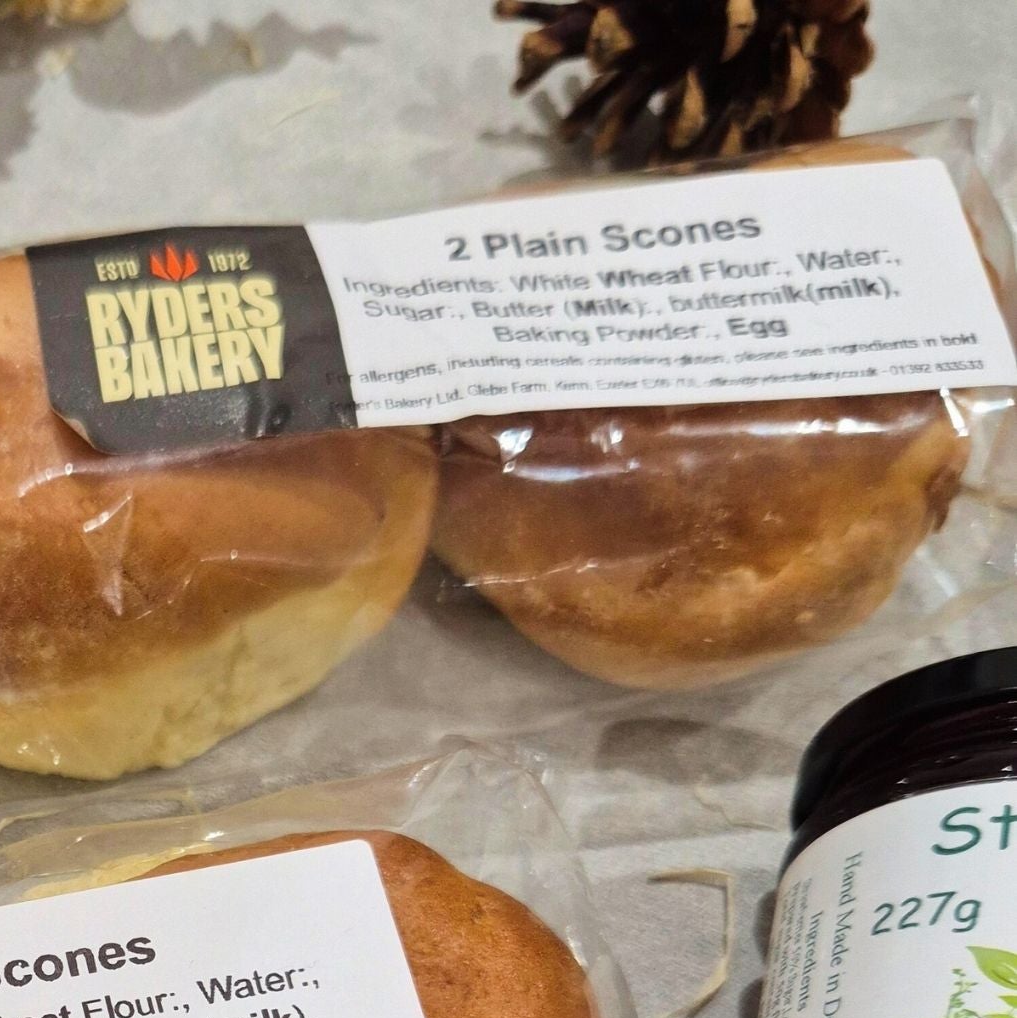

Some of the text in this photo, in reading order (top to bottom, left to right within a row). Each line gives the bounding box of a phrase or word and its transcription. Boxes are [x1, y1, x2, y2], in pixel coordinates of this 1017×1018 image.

[446, 216, 761, 261] 2 Plain Scones
[95, 251, 252, 281] ESTD 1972
[343, 276, 499, 299] Ingredients:
[510, 274, 589, 294] White
[597, 263, 693, 290] Wheat
[86, 278, 281, 347] RYDERS
[471, 301, 554, 319] Butter
[493, 325, 589, 346] Baking
[727, 316, 788, 339] Egg
[96, 324, 285, 403] BAKERY
[839, 851, 862, 907] Hand
[871, 891, 982, 936] 227g
[797, 910, 823, 1012] Ingredients
[830, 909, 854, 968] Made
[197, 966, 320, 1005] Water:,
[826, 972, 846, 994] in
